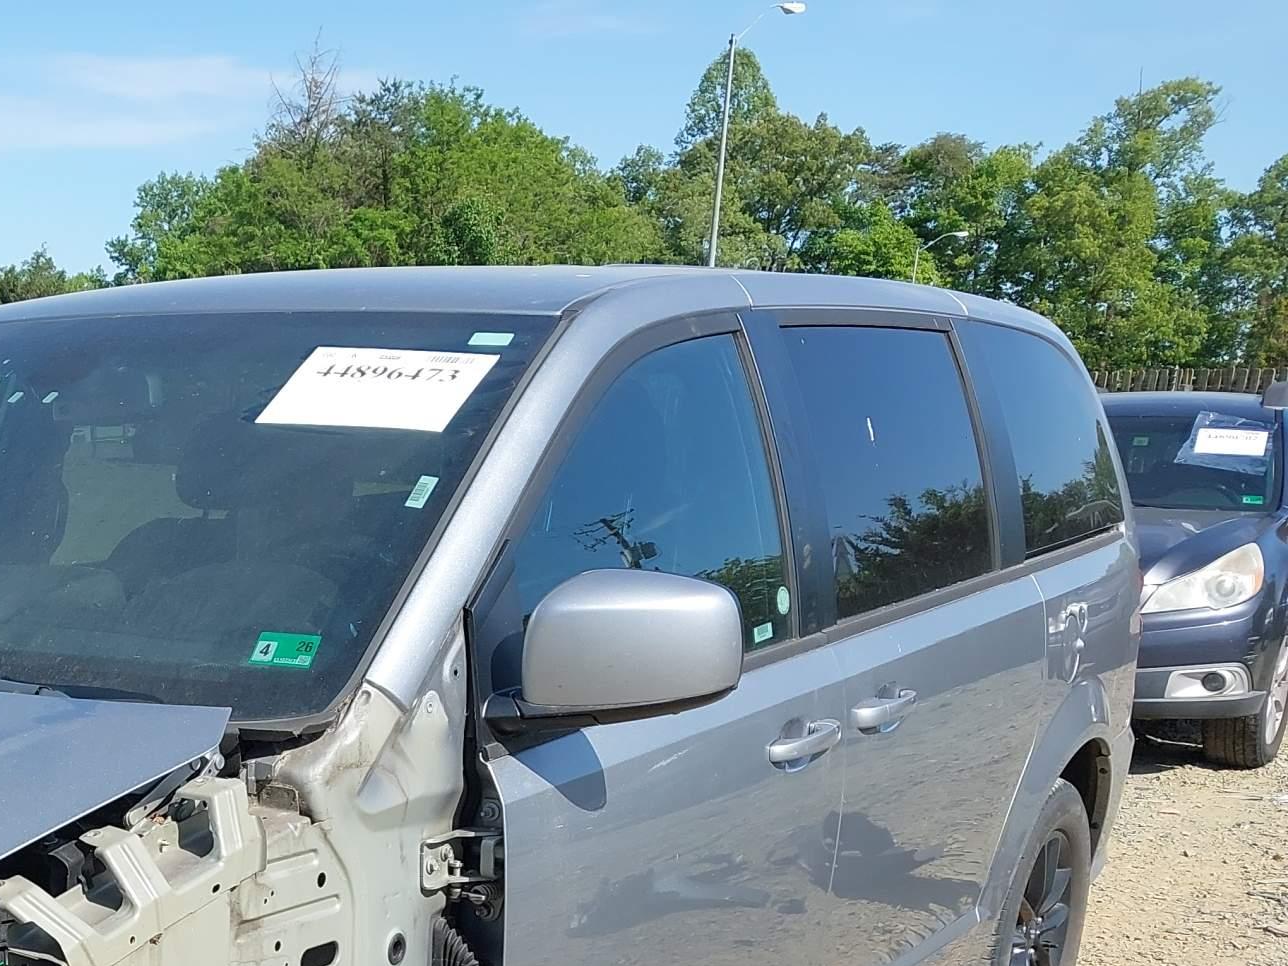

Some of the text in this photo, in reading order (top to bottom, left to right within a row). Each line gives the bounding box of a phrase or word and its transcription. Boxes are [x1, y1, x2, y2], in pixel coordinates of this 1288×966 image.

[316, 363, 461, 383] 44896473
[258, 640, 314, 657] 4 26
